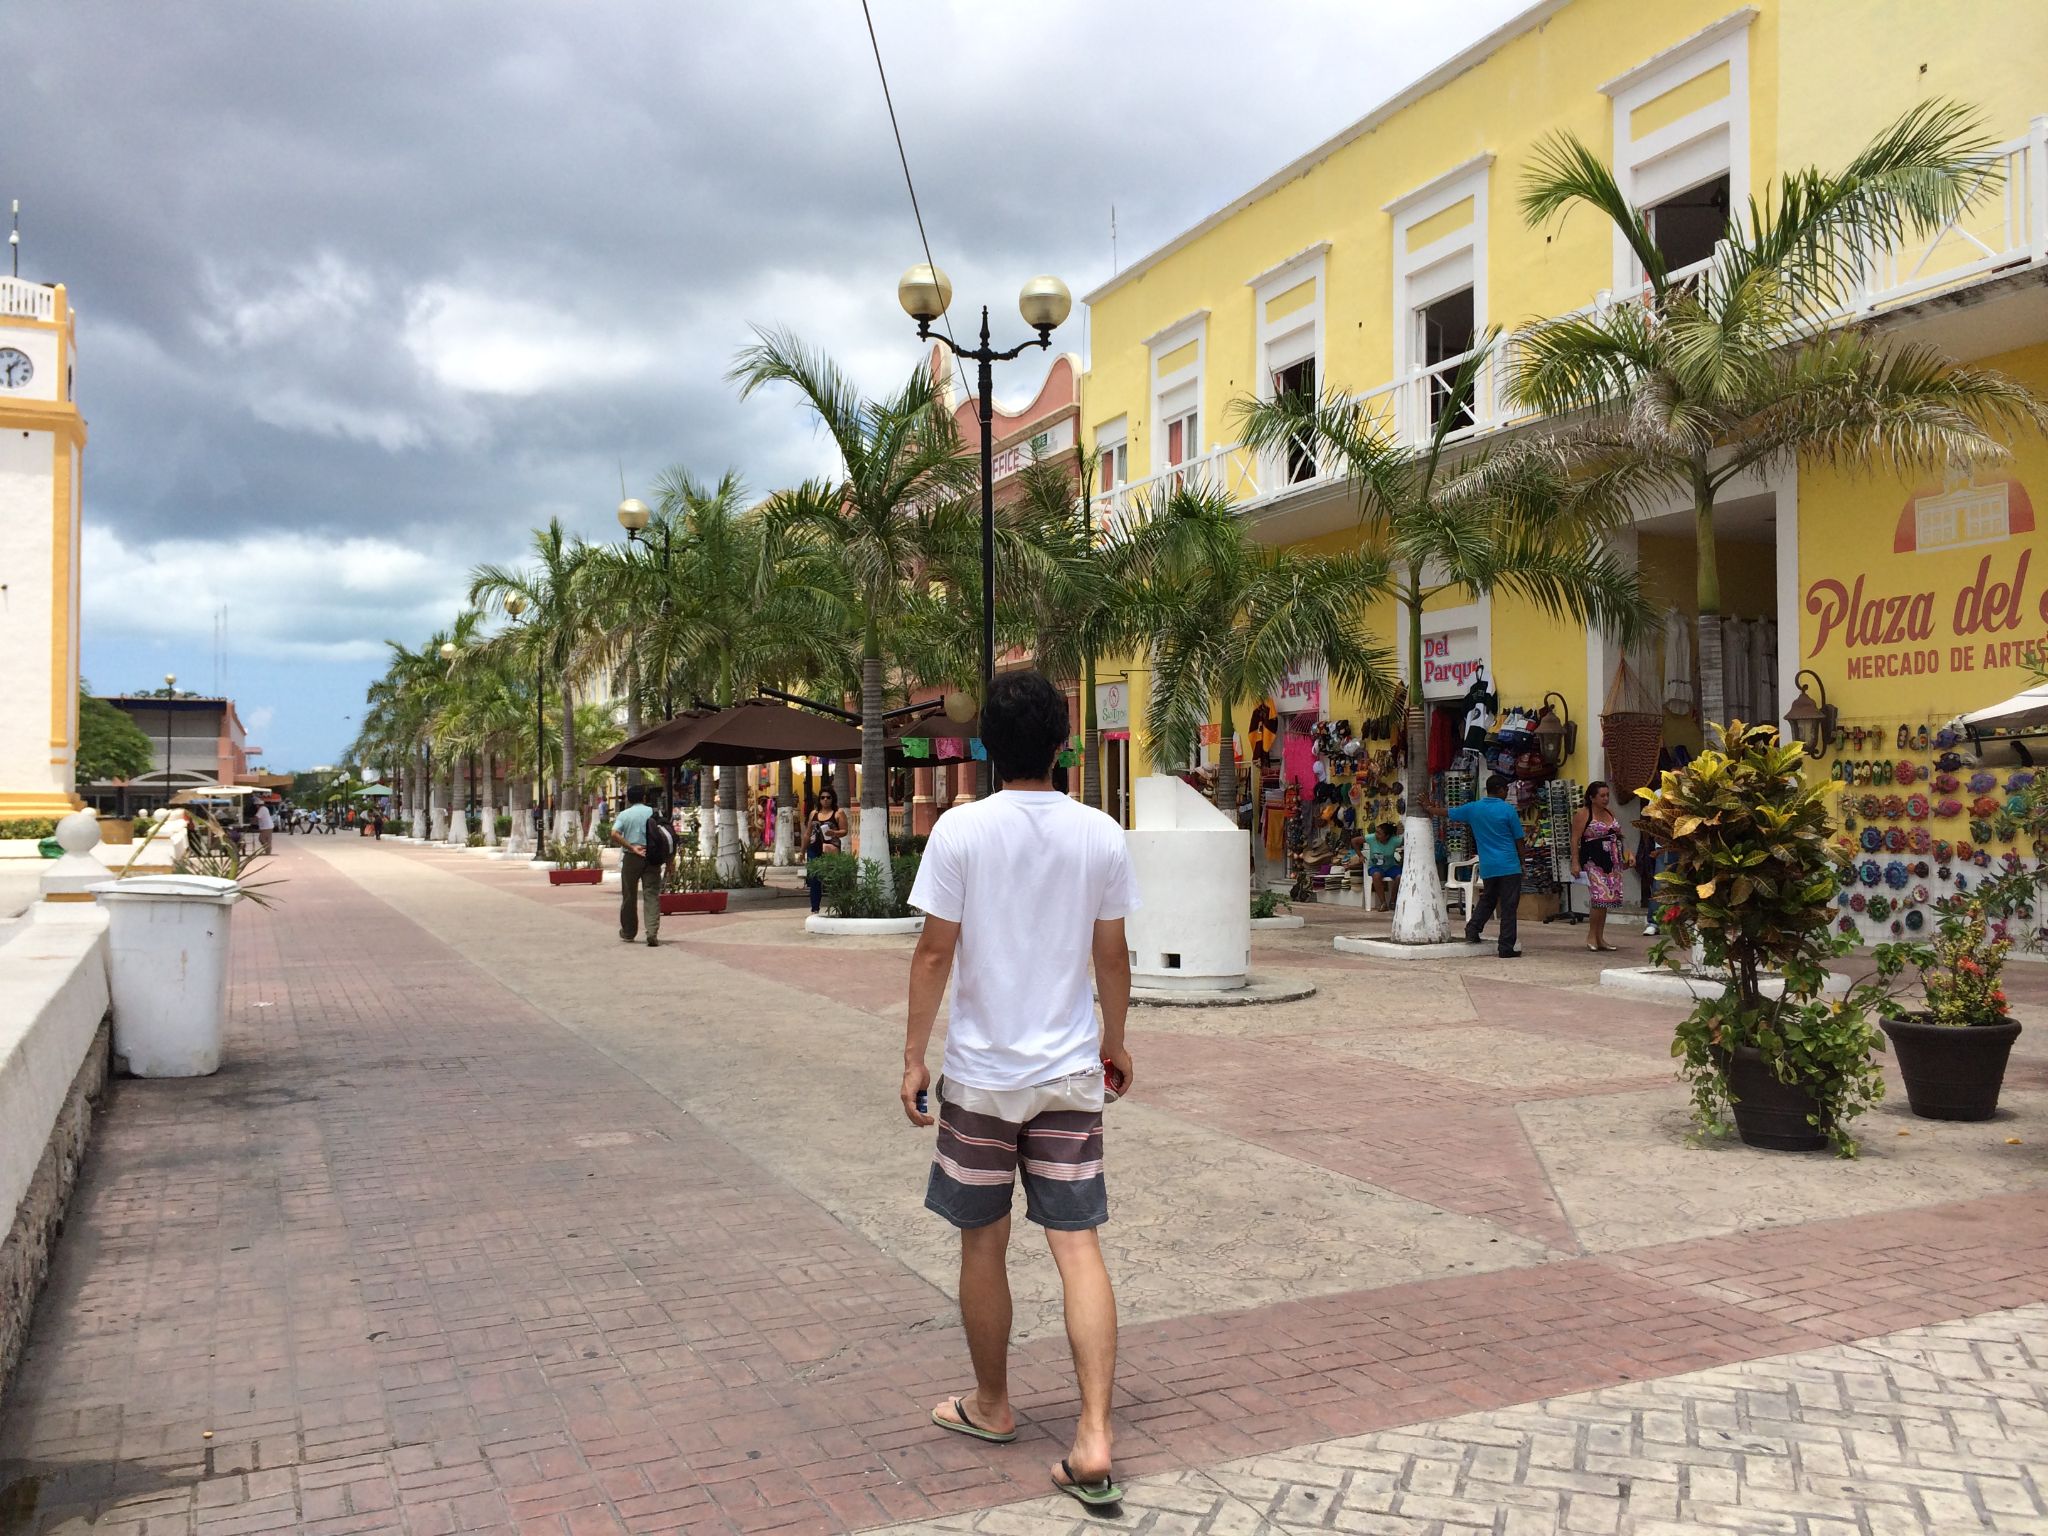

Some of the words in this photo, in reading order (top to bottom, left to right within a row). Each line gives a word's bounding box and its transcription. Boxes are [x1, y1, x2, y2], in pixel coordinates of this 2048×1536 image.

[1805, 573, 1936, 659] Plaza
[1952, 548, 2032, 636] del
[1424, 634, 1449, 659] Del
[1847, 649, 1940, 680] MERCADO
[1950, 645, 1975, 672] DE
